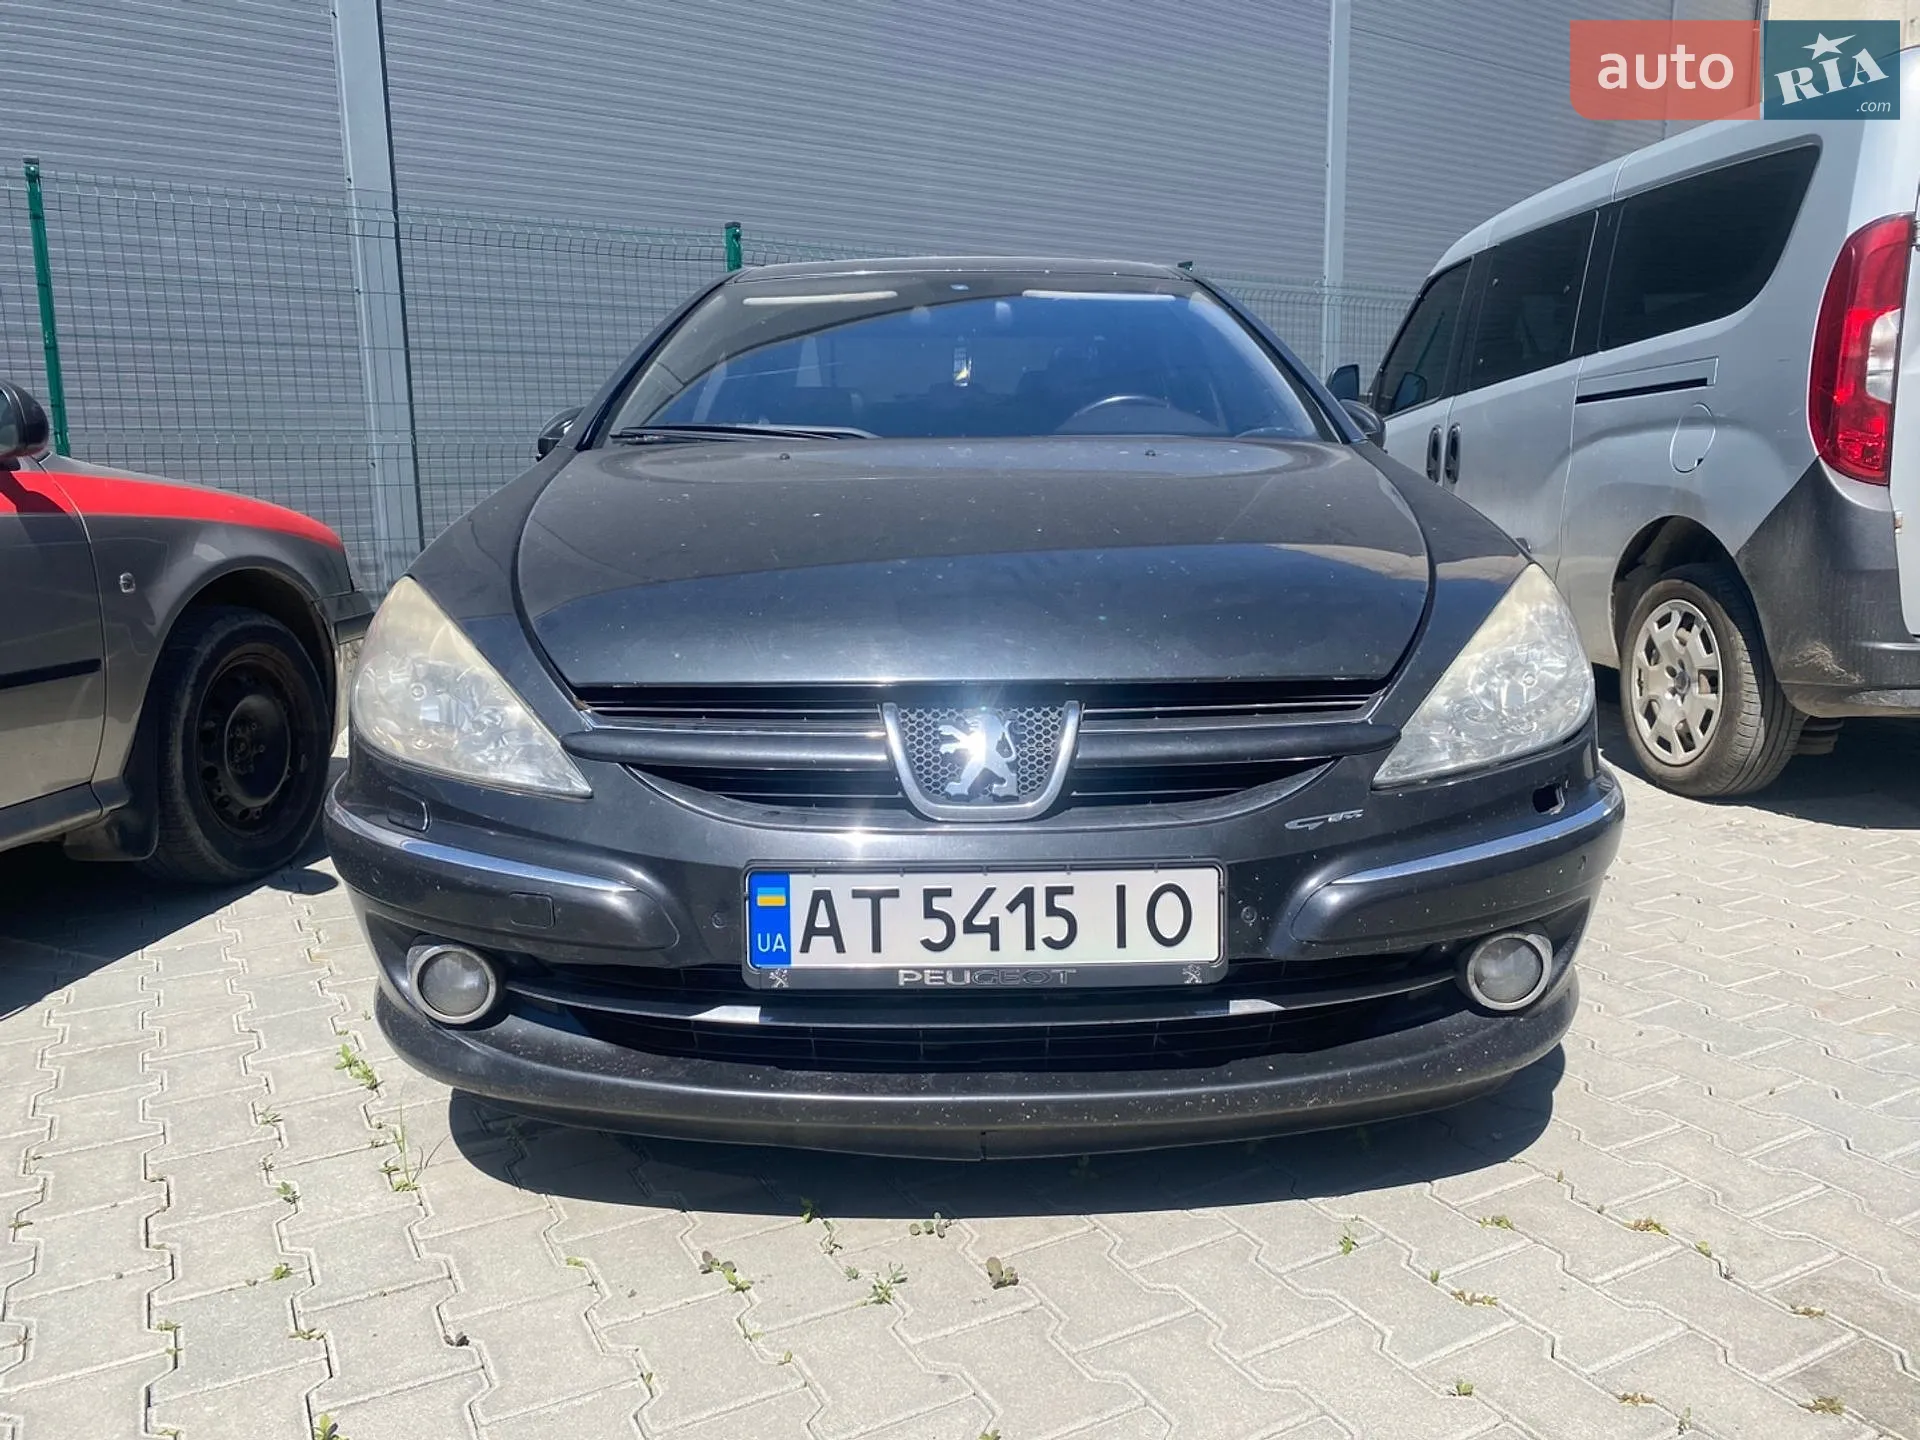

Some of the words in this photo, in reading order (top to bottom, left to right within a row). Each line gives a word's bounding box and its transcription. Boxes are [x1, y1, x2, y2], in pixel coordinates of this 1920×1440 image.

[799, 888, 899, 954] AT
[919, 884, 1078, 953] 5415
[757, 933, 787, 953] UA
[898, 969, 1077, 986] PEUGEOT
